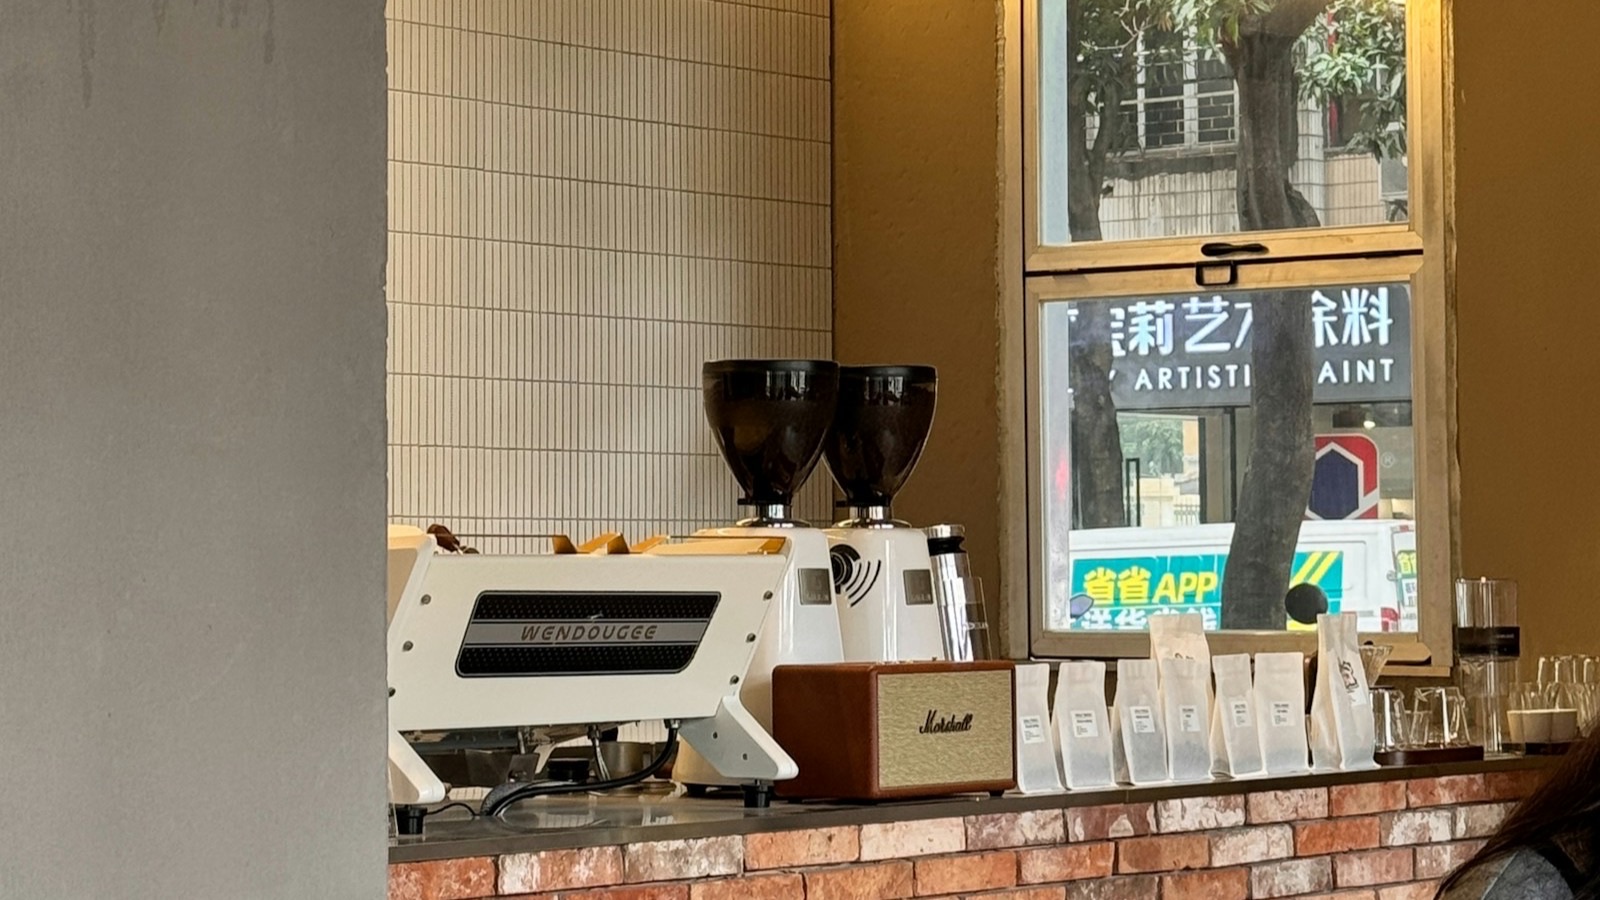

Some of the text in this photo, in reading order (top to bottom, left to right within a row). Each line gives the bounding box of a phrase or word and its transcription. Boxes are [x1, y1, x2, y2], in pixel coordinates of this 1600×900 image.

[1134, 358, 1394, 391] ARTISTI AINT
[1083, 565, 1218, 605] 省省APP
[520, 624, 658, 642] WENDOUGEE
[919, 709, 974, 734] Marshall
